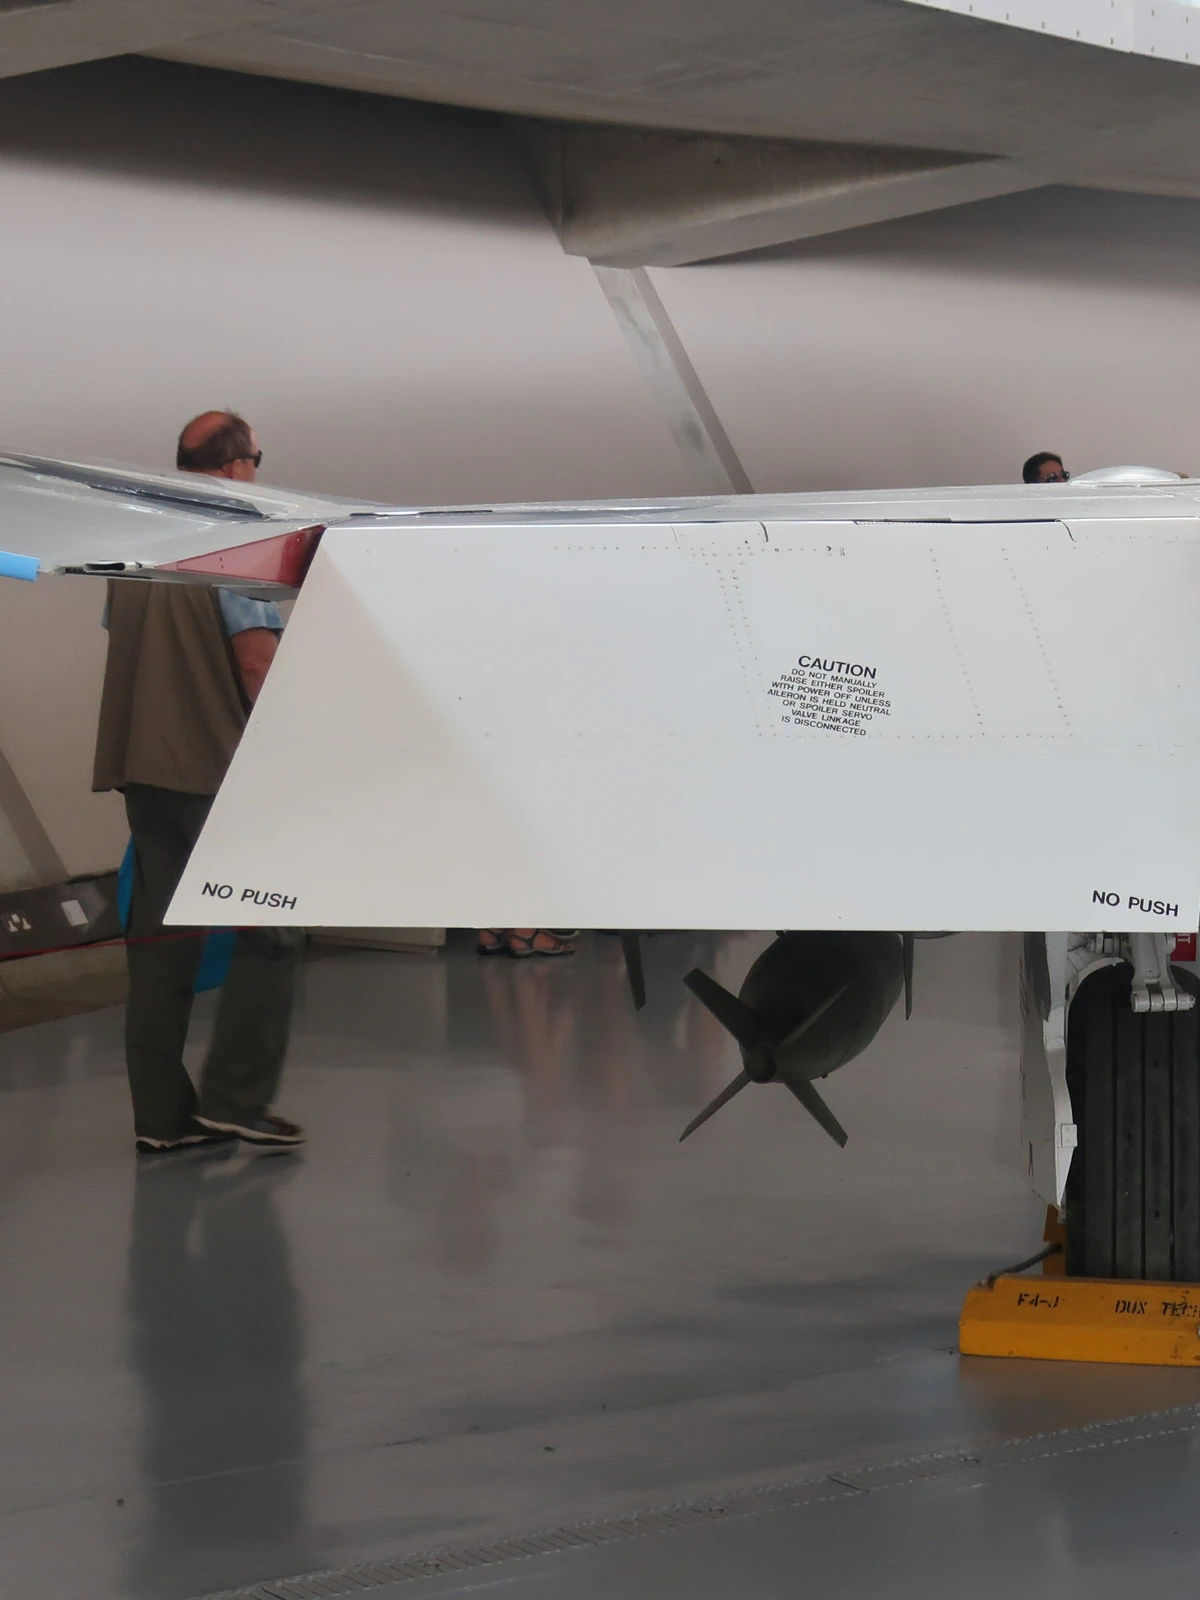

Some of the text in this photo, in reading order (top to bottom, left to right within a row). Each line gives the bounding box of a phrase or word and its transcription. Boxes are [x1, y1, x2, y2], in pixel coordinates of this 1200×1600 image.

[791, 668, 878, 689] DO NOT MANUALLY
[798, 655, 877, 679] CAUTION
[771, 681, 891, 708] WITH POWER OFF UNLESS
[780, 674, 885, 698] RAISE EITHER SPOILER
[767, 689, 891, 716] AILERON IS HELD NEUTRAL
[782, 699, 873, 721] OR SPOILER SERVO
[781, 715, 867, 736] IS DISCONNECTED
[791, 709, 861, 727] VALVE LINKAGE
[201, 882, 297, 910] NO PUSH
[1092, 890, 1179, 917] NO PUSH
[1017, 1293, 1060, 1309] F4-J
[1115, 1299, 1148, 1315] DUX
